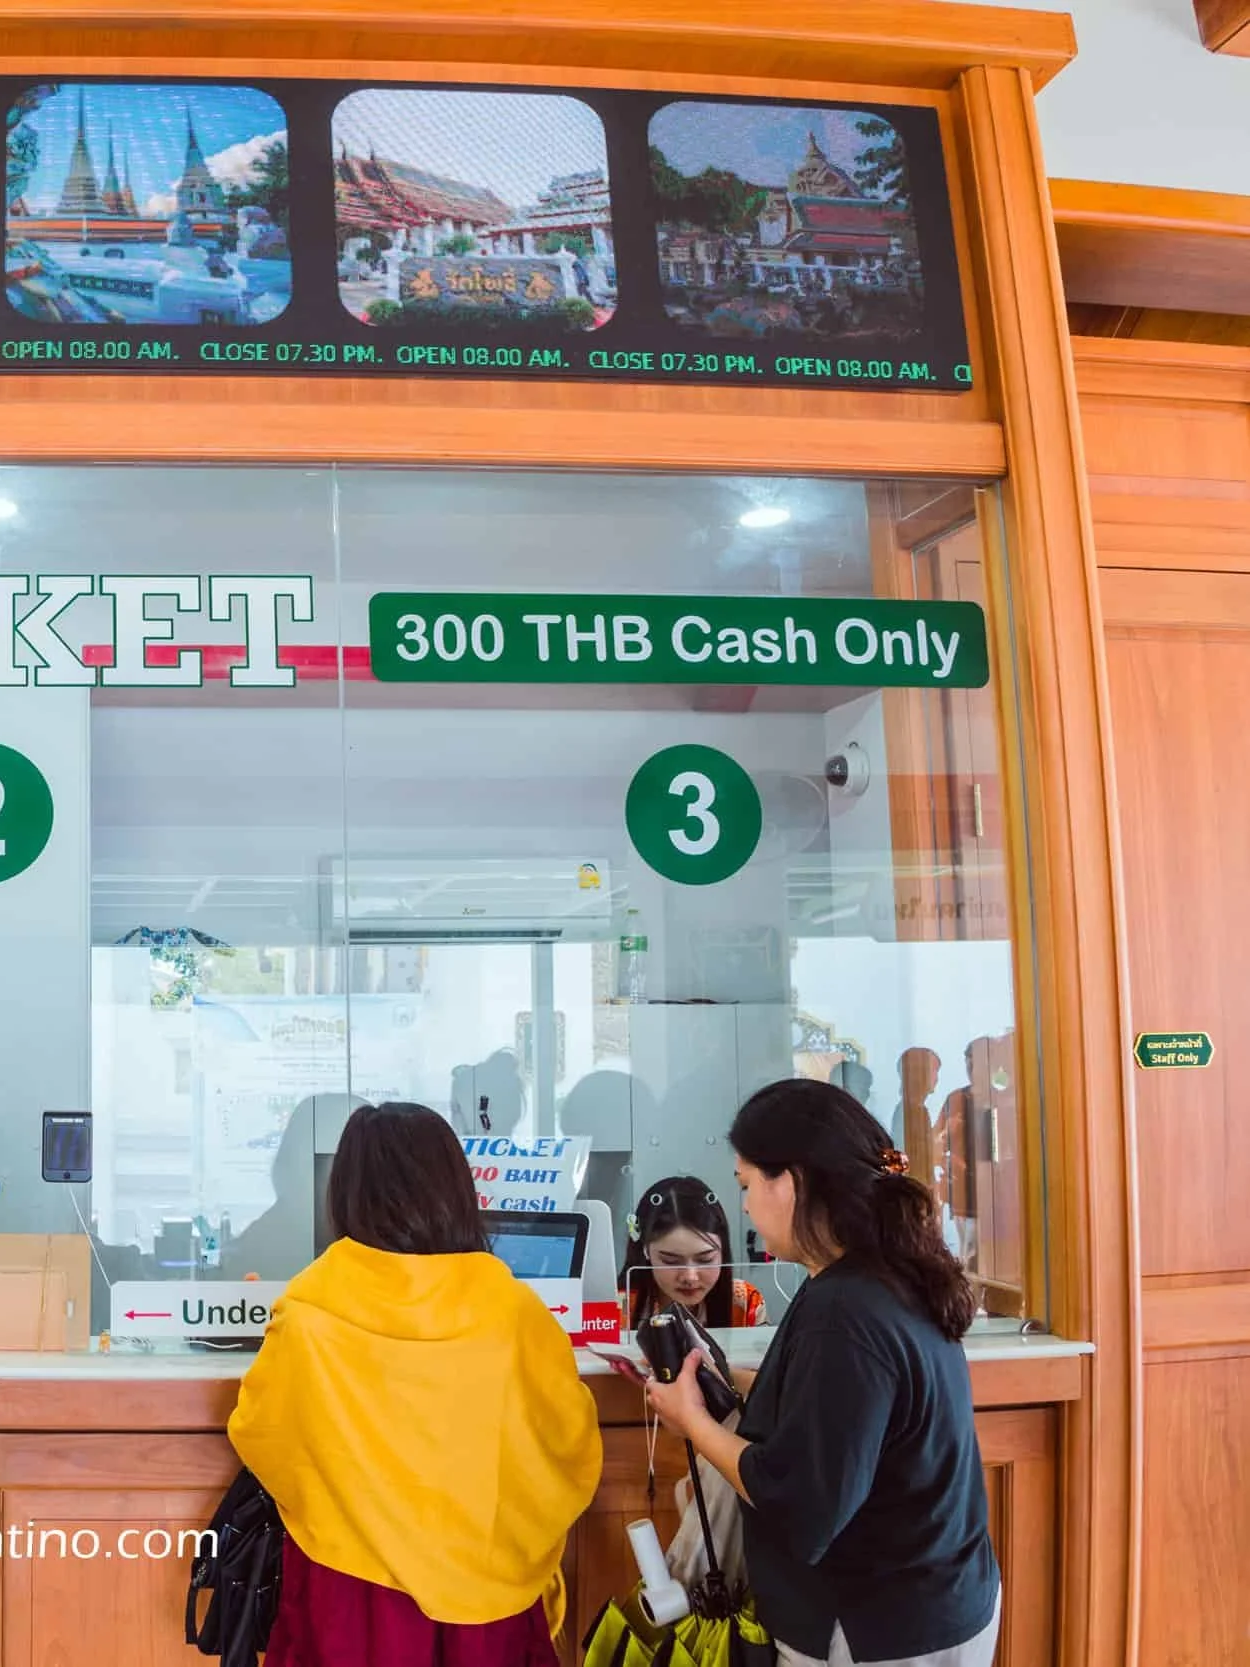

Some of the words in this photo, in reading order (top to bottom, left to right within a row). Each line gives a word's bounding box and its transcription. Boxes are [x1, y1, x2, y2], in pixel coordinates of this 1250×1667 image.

[2, 341, 63, 359] OPEN
[70, 341, 130, 359] 08.00
[138, 342, 179, 360] AM.
[200, 343, 269, 361] CLOSE
[276, 344, 336, 362] 07.30
[343, 345, 383, 363] PM.
[397, 346, 456, 365] OPEN
[463, 347, 522, 366] 08.00
[529, 349, 570, 367] AM.
[589, 351, 655, 370] CLOSE
[662, 354, 719, 372] 07.30
[725, 355, 763, 373] PM.
[776, 357, 832, 376] OPEN
[837, 360, 893, 379] 08.00
[898, 362, 937, 381] AM.
[396, 614, 504, 662] 300
[523, 614, 653, 662] THB
[671, 616, 817, 664] Cash
[835, 618, 960, 678] Only
[668, 771, 721, 855] 3
[1151, 1053, 1175, 1064] Staff
[1177, 1052, 1199, 1064] Only
[471, 1166, 499, 1183] 00
[504, 1168, 562, 1185] BAHT
[182, 1298, 273, 1326] Unde
